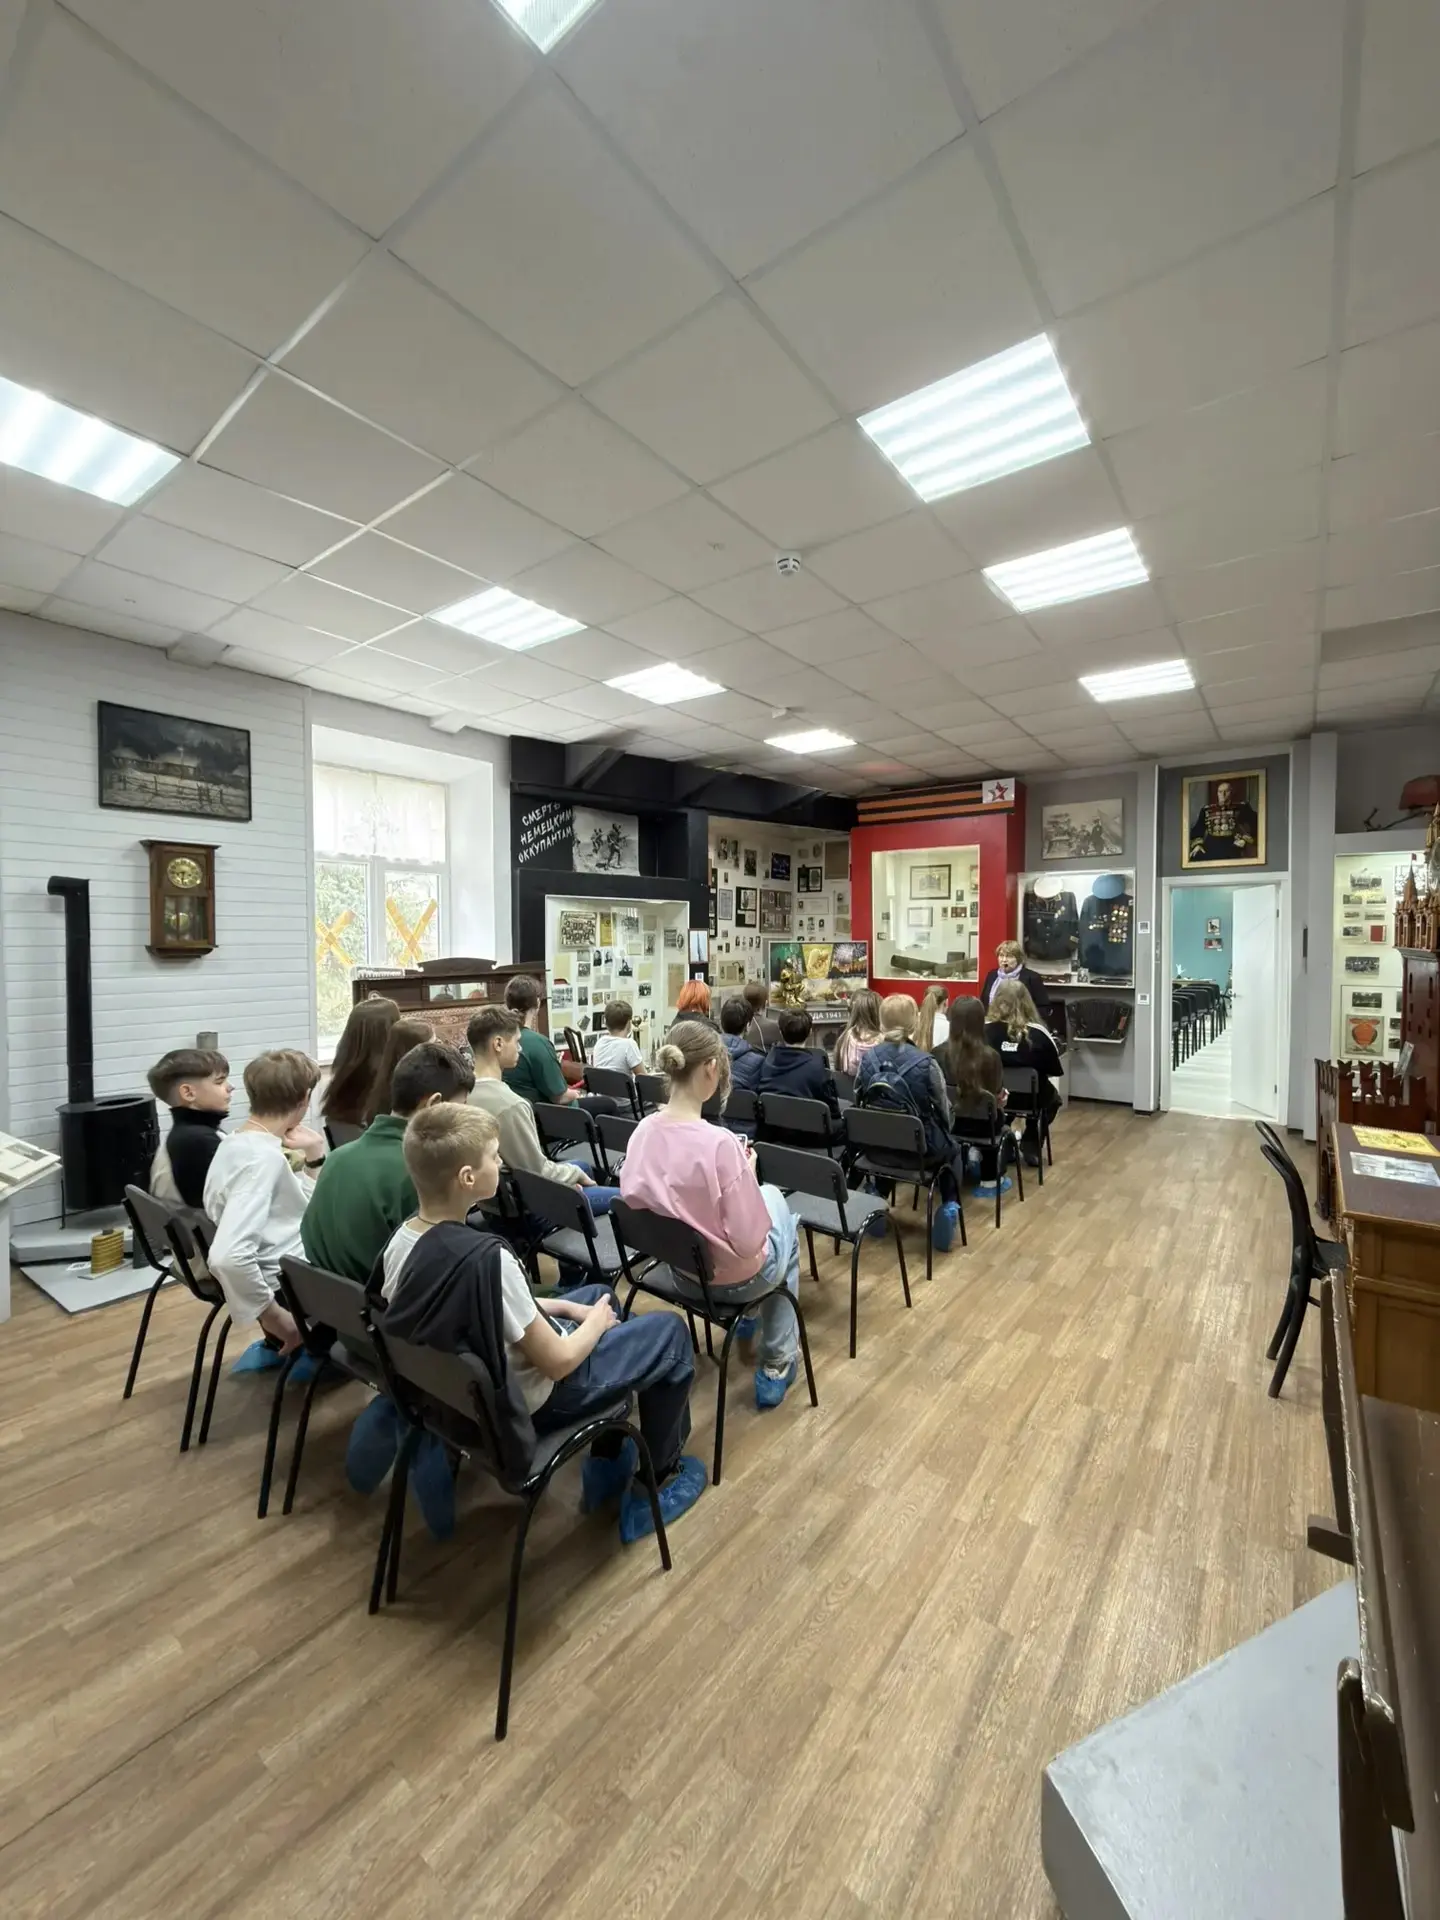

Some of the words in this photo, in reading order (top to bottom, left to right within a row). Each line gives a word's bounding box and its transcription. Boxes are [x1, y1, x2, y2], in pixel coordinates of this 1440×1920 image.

[520, 809, 571, 845] НЕМЕЦКИМ
[522, 802, 560, 826] СМЕРТЬ
[518, 826, 572, 863] ОККУПАНТАМ
